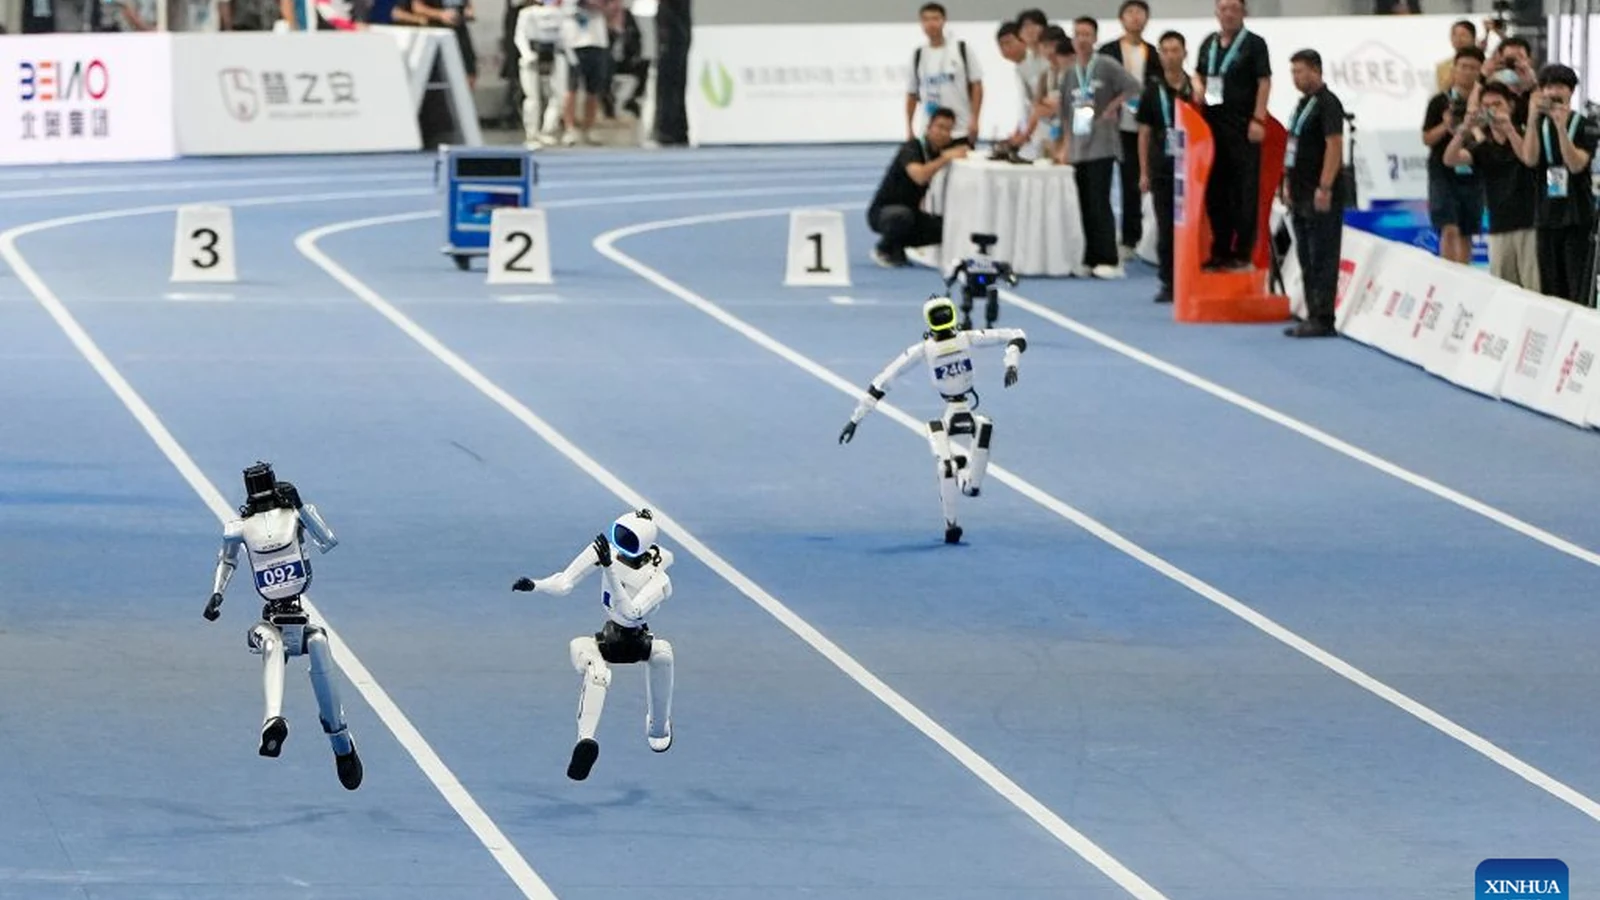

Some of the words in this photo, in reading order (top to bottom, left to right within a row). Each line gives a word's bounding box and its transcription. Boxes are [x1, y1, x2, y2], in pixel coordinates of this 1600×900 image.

[191, 228, 219, 269] 3
[505, 231, 533, 272] 2
[806, 232, 831, 272] 1
[263, 564, 297, 586] 092
